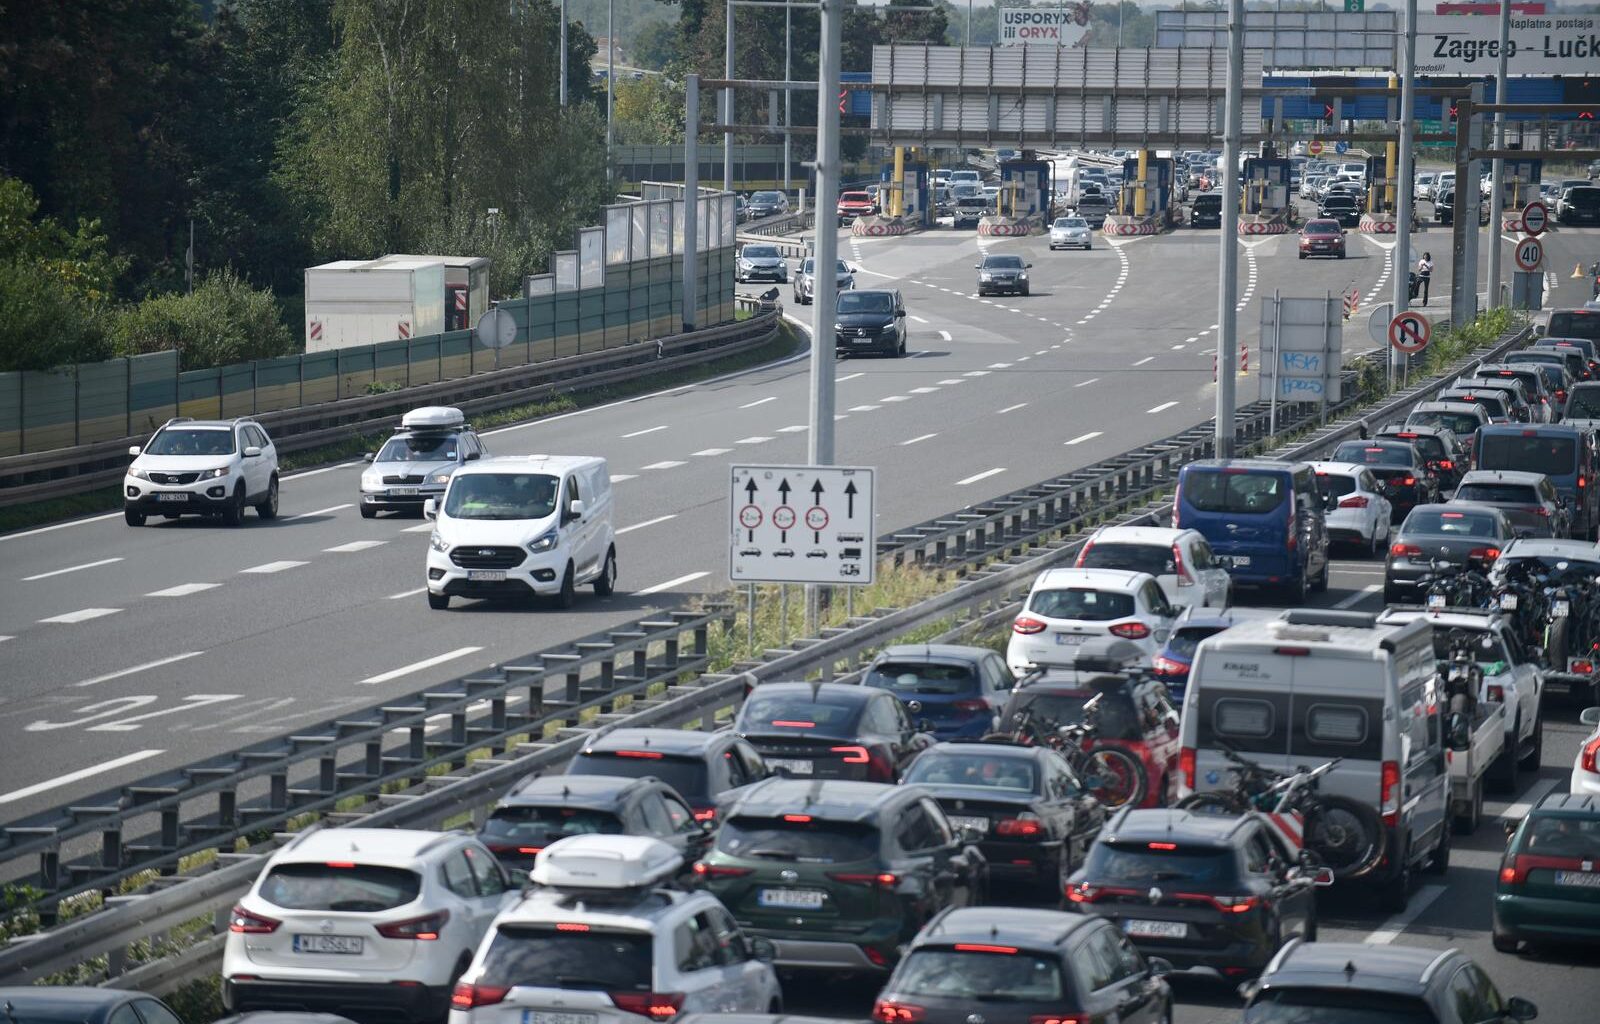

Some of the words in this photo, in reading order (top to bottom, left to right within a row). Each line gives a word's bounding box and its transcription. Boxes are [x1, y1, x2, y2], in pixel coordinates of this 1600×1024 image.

[1004, 12, 1071, 25] USPORYX
[1556, 19, 1594, 31] postaja
[1004, 26, 1016, 39] ili
[1019, 27, 1058, 39] ORYX
[1522, 246, 1538, 262] 40
